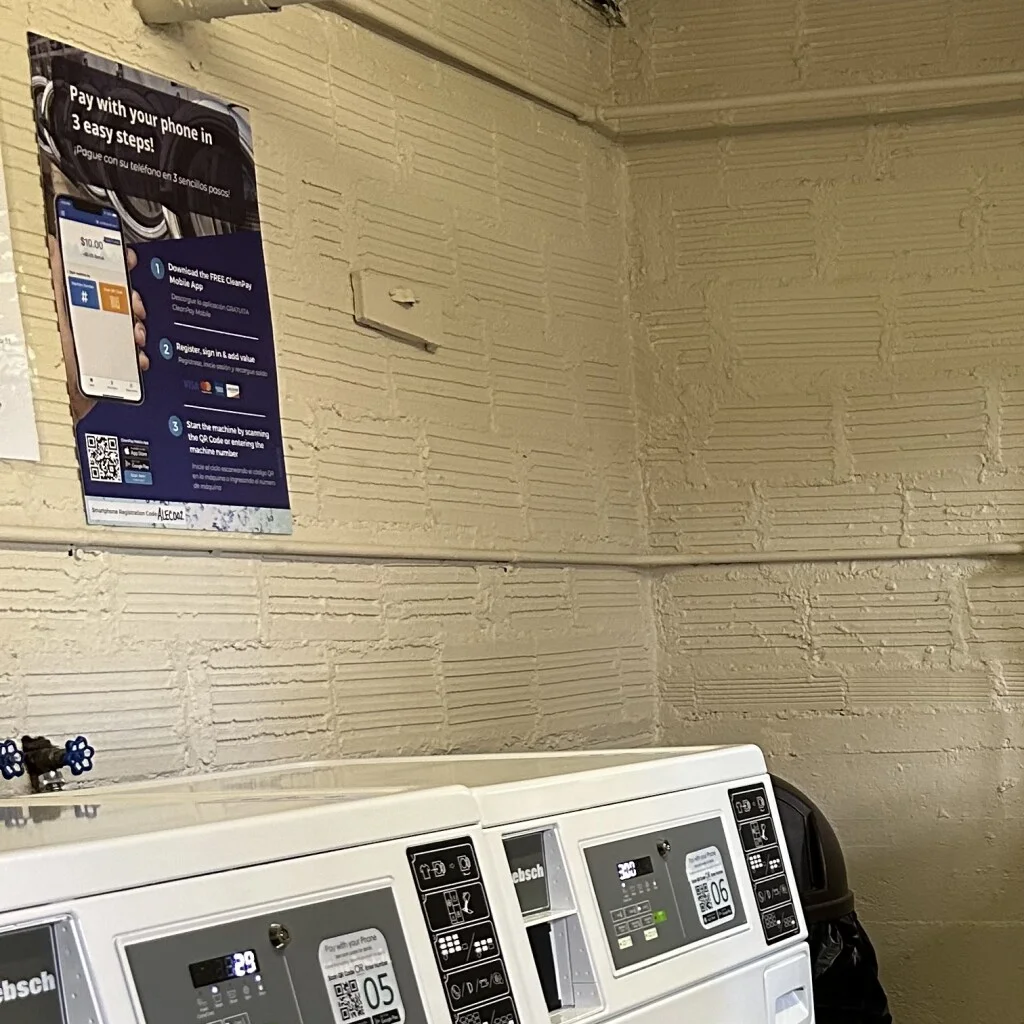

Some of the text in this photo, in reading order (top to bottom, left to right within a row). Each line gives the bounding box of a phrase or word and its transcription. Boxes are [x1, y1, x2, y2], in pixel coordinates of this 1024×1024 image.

[70, 85, 213, 146] Pay with your phone in
[72, 114, 154, 153] 3 easy steps!
[74, 145, 230, 198] ¡Pague con su teléfono en 3 sencillos pasos!
[80, 236, 104, 250] $10.00
[156, 264, 160, 274] 1
[168, 263, 252, 291] Download the FREE CleanPay
[169, 276, 204, 291] Mobile App
[164, 344, 170, 354] 2
[176, 342, 256, 363] Register, sign in & add value
[172, 421, 178, 432] 3
[186, 420, 270, 440] Start the machine by scanning
[188, 434, 198, 442] the
[200, 434, 208, 444] QR
[208, 436, 224, 444] Code
[231, 440, 254, 449] entering
[254, 440, 264, 449] the
[190, 446, 238, 458] machine number
[710, 878, 728, 905] 06
[234, 950, 257, 976] 29
[354, 964, 364, 974] OR
[364, 972, 394, 1010] 05
